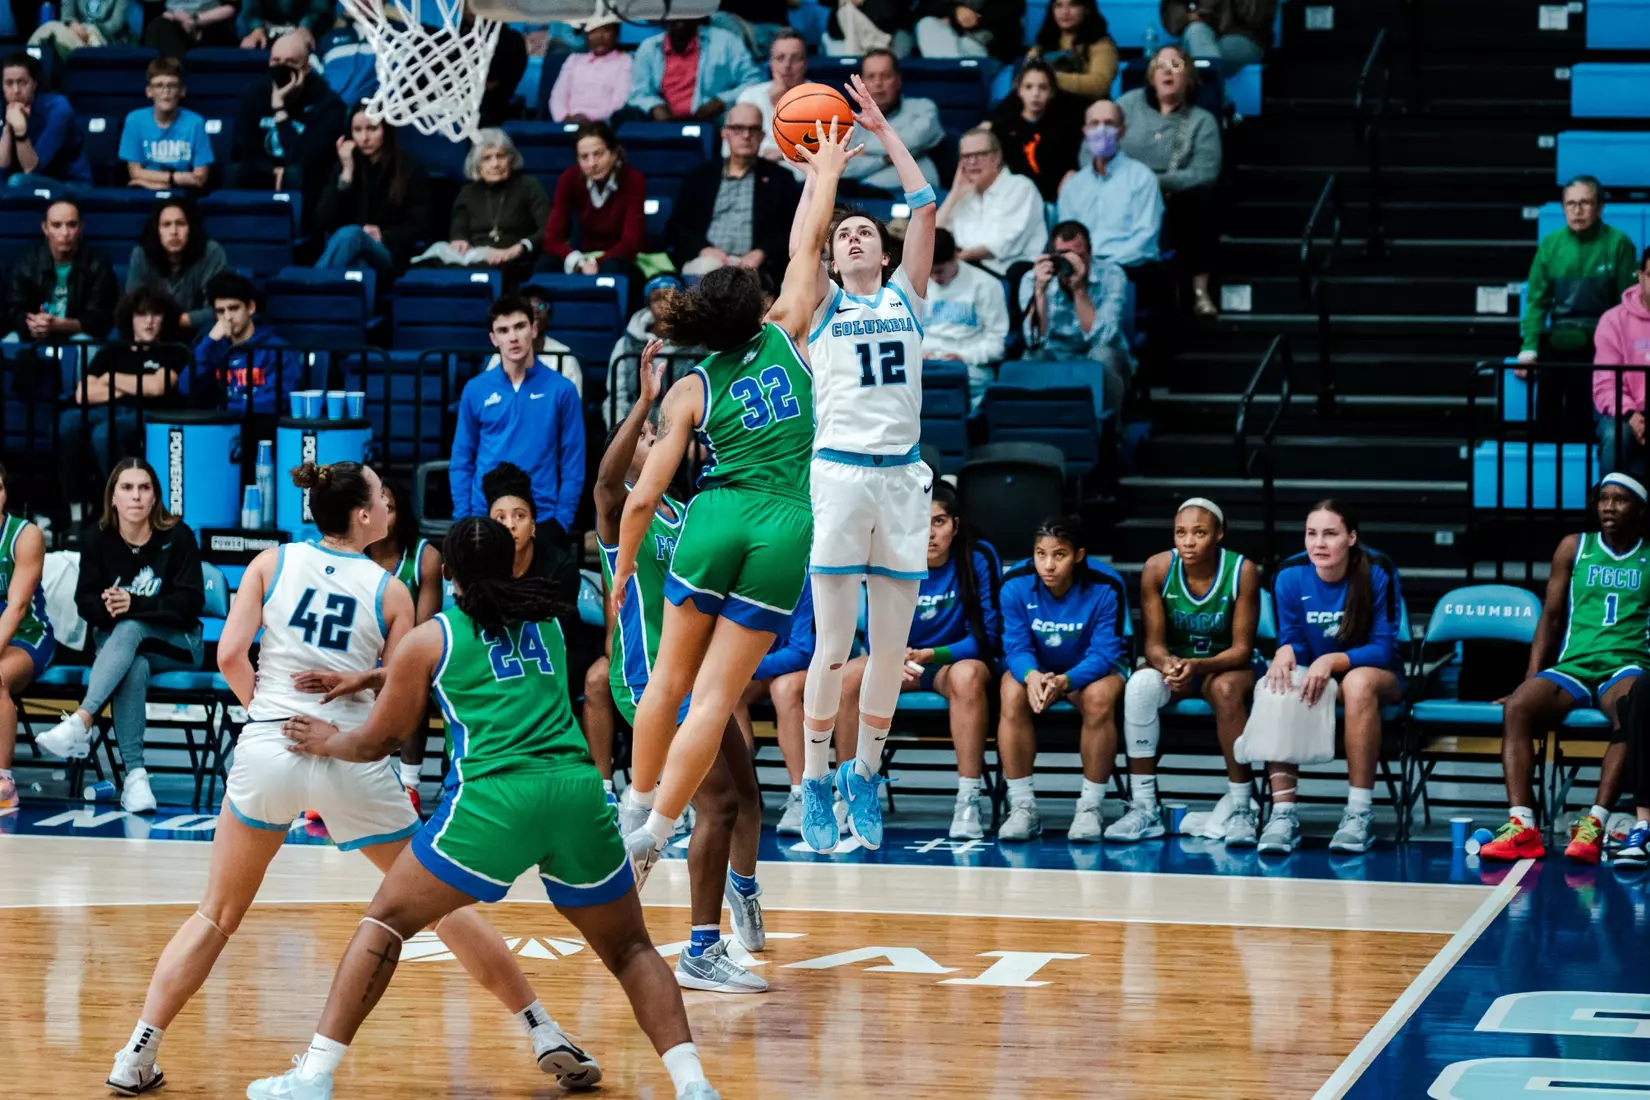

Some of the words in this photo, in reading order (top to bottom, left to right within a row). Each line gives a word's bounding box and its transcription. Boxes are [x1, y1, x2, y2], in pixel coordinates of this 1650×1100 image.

[831, 317, 914, 338] COLUMBIA
[856, 341, 907, 388] 12
[729, 364, 801, 432] 32
[170, 431, 183, 516] POWERADE
[213, 537, 242, 550] POWER
[1587, 565, 1641, 590] FGCU
[288, 588, 357, 652] 42
[1174, 609, 1224, 633] FGCU
[1444, 603, 1532, 617] COLUMBIA
[1602, 592, 1618, 626] 1
[481, 620, 555, 682] 24
